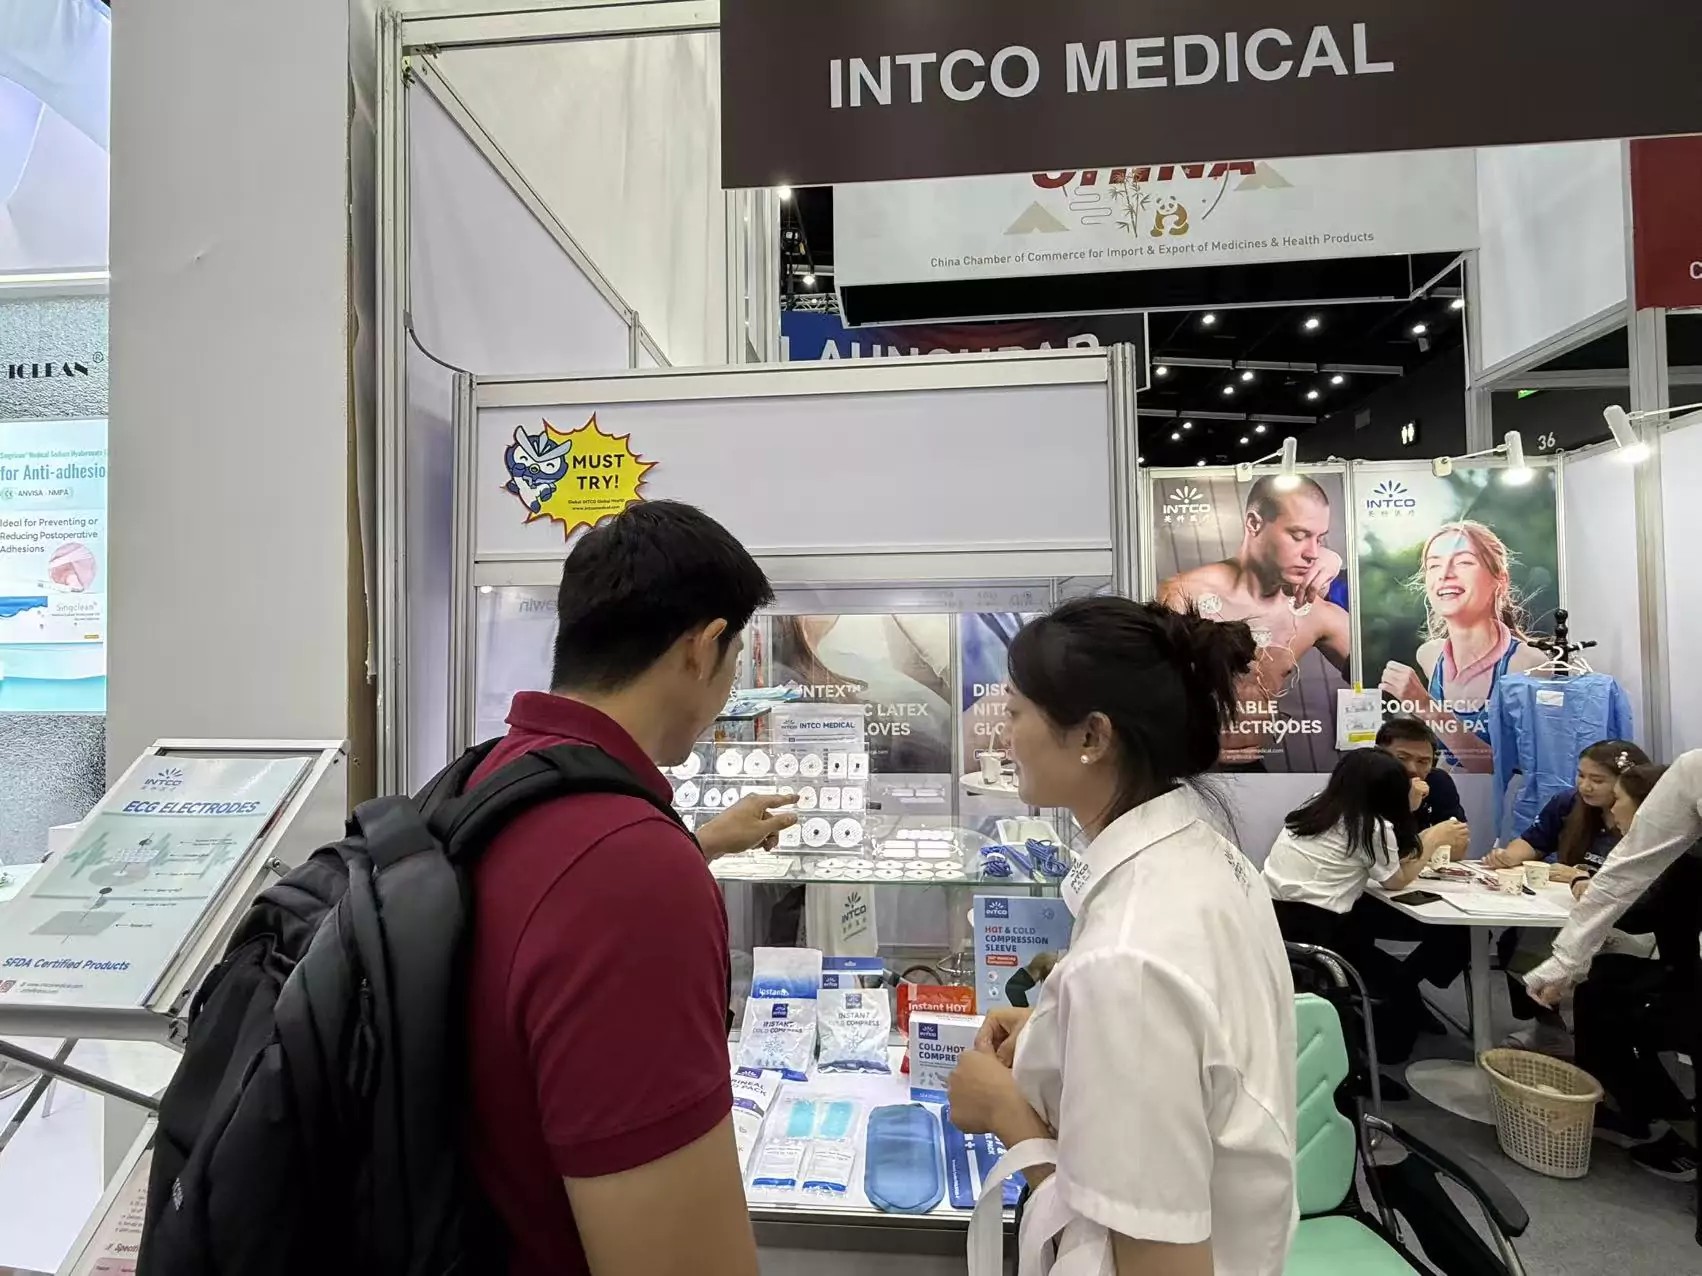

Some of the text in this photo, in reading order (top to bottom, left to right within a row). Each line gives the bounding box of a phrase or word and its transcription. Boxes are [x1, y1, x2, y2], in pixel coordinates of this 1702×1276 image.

[830, 23, 1394, 108] INTCO MEDICAL
[931, 232, 1374, 267] China Chamber of Commerce for Import & Export of Medicines & Health Products
[1538, 431, 1556, 450] 36
[572, 454, 625, 469] MUST
[0, 463, 106, 480] for Anti-adhesio
[576, 474, 619, 490] TRY!
[1163, 503, 1211, 514] INTCO
[1366, 498, 1416, 508] INTCO
[0, 519, 22, 527] Ideal
[24, 518, 37, 527] for
[39, 517, 86, 527] Preventing
[0, 530, 98, 541] Reducing Postoperative
[0, 545, 45, 553] Adhesions
[877, 703, 928, 716] LATEX
[1382, 699, 1425, 714] COOL
[1429, 699, 1479, 713] NECK
[864, 722, 911, 736] OVES
[1221, 719, 1323, 734] ECTRODES
[122, 800, 261, 814] ECG ELECTRODES
[841, 904, 867, 924] INTCO
[985, 926, 1036, 935] HOT & COLD
[985, 935, 1049, 945] COMPRESSION
[985, 944, 1017, 952] SLEEVE
[2, 957, 131, 971] SFDA Certified Products
[908, 1002, 968, 1012] Instant HOT
[838, 1012, 870, 1020] INSTANT
[918, 1042, 966, 1054] COLD/HOT
